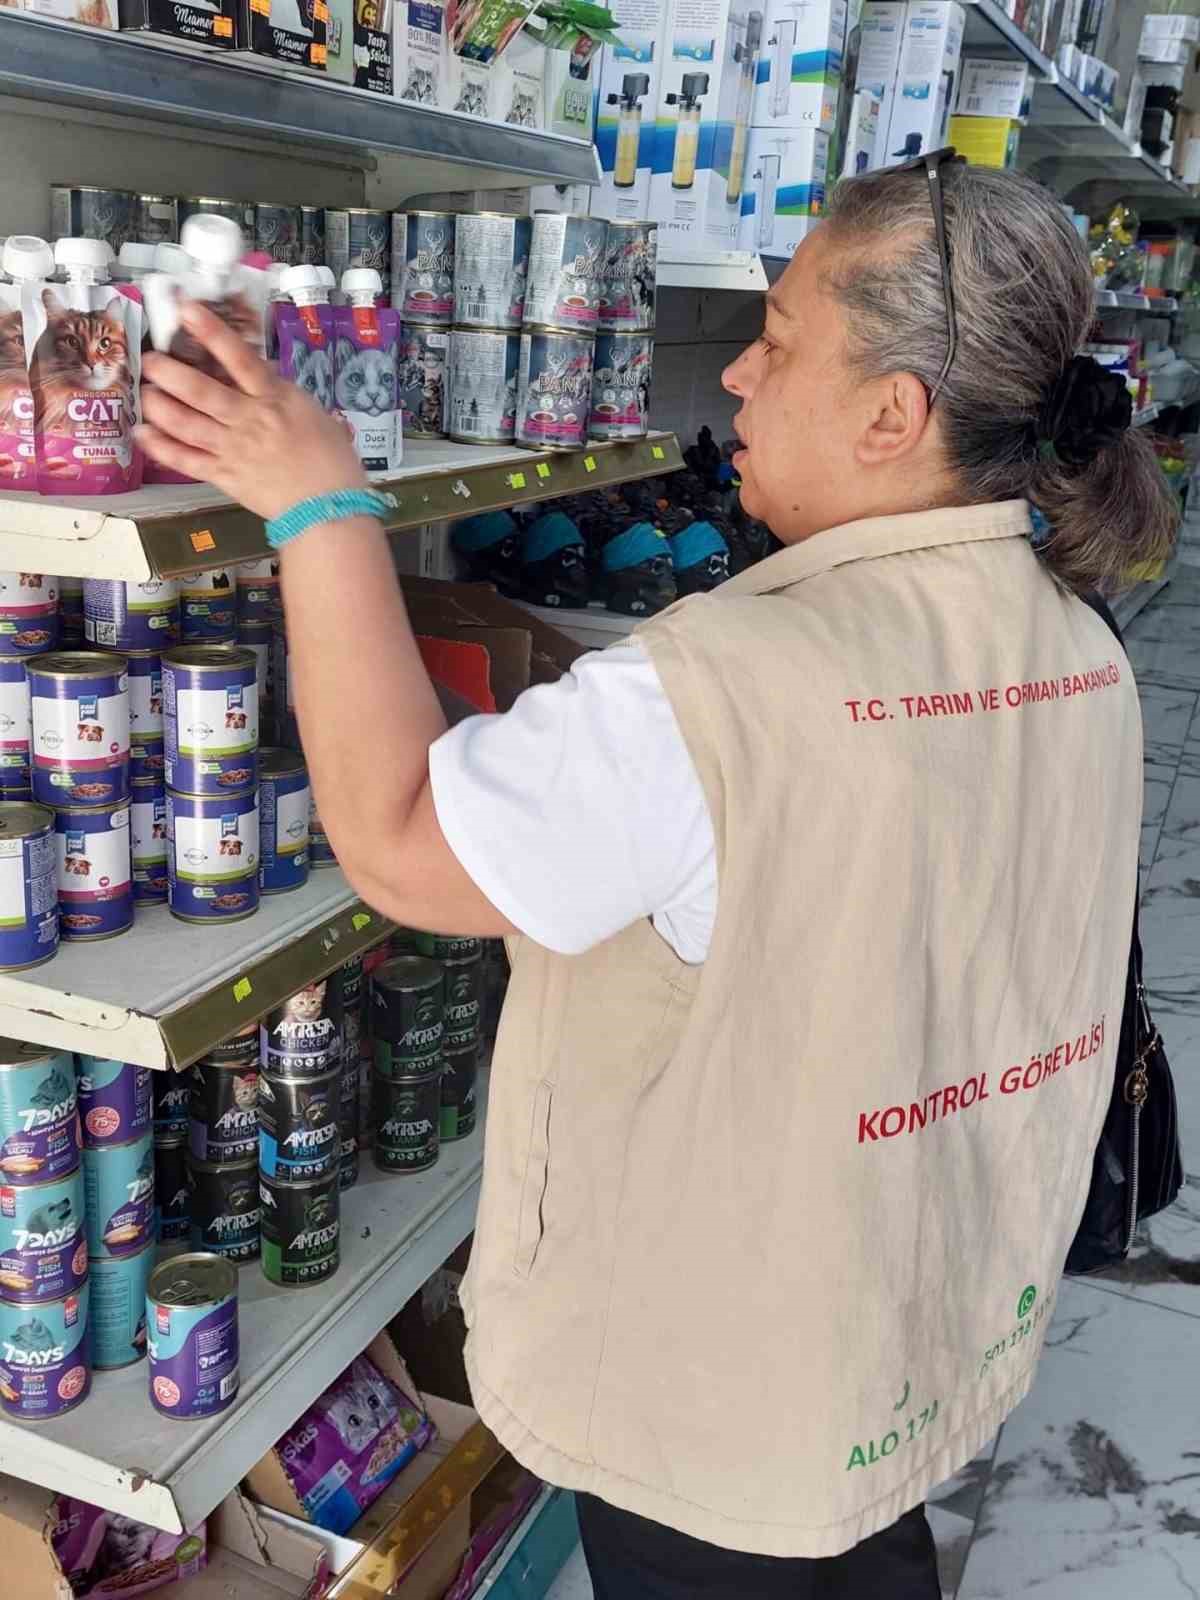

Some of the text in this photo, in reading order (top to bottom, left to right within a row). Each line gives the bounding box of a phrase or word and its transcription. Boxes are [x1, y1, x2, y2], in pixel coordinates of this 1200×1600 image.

[368, 32, 387, 50] Tasty
[68, 399, 122, 422] CAT
[365, 433, 386, 443] Duck
[845, 700, 894, 722] T.C.
[900, 692, 973, 719] TARIM
[977, 689, 999, 711] VE
[1005, 680, 1060, 708] ORMAN
[858, 1014, 1106, 1143] KONTROL GÖREVLİSİ
[284, 1423, 319, 1460] skas
[846, 1431, 899, 1471] ALO
